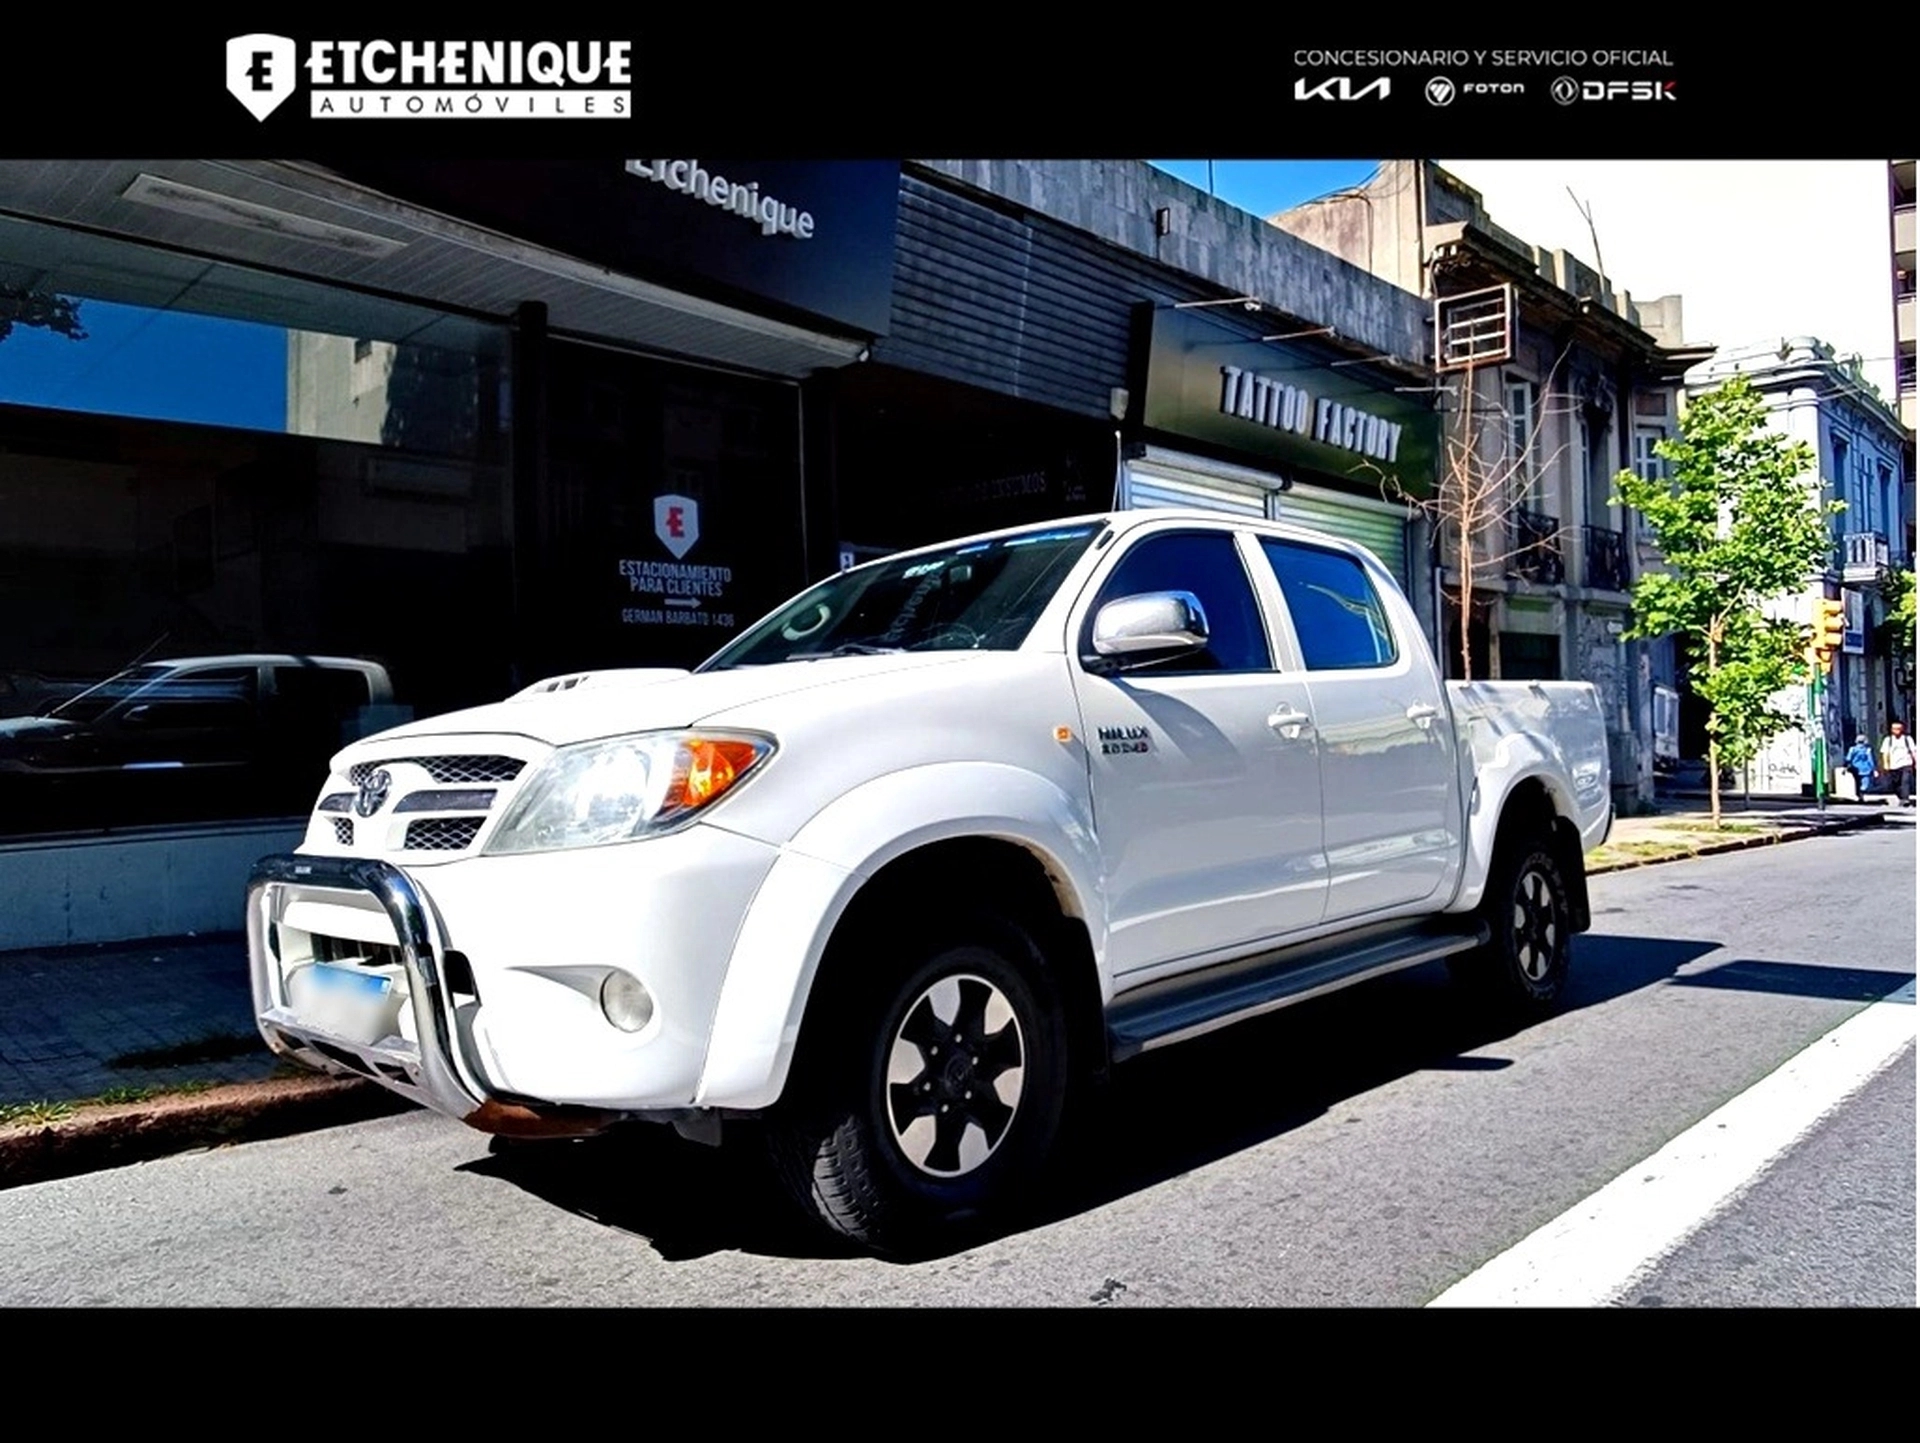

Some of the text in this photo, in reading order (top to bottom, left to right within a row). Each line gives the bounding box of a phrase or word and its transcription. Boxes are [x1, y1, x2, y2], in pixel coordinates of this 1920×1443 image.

[1220, 365, 1402, 463] TATTOO FACTORY
[618, 559, 732, 583] ESTACIONAMIENTO
[630, 577, 723, 597] PARA CLIENTES
[621, 608, 663, 624] GERMAN
[1097, 726, 1149, 741] HILUX
